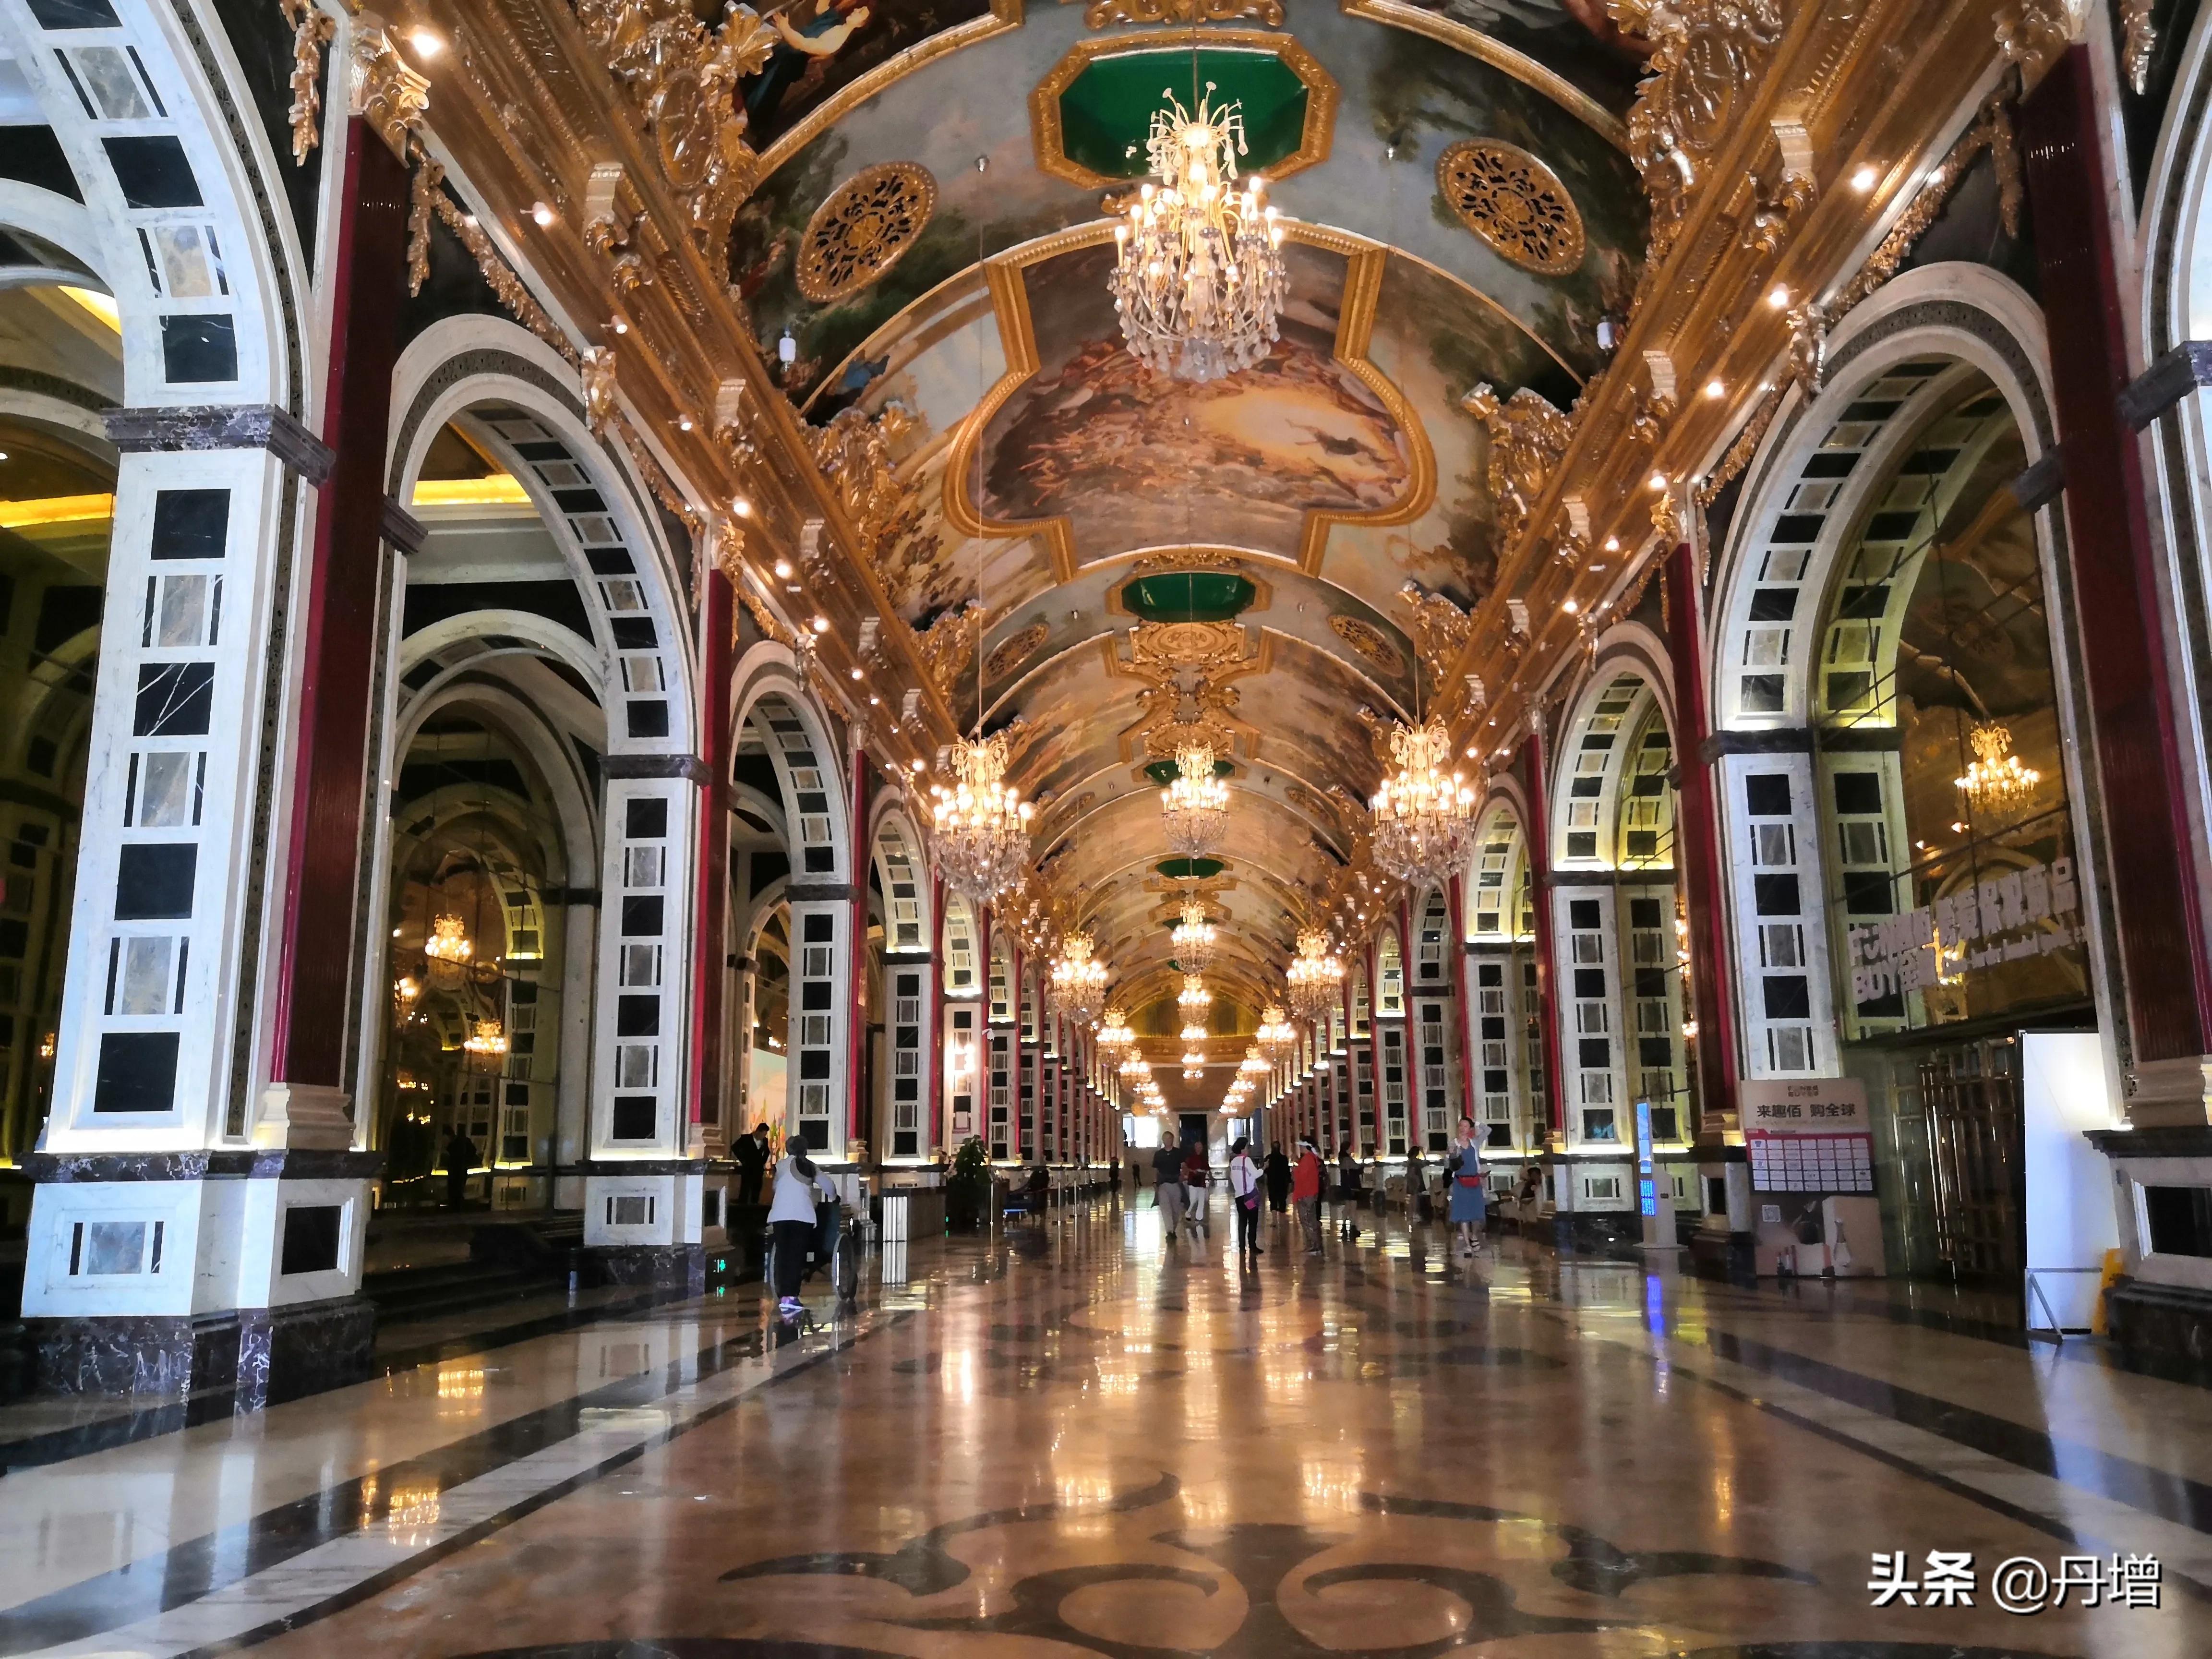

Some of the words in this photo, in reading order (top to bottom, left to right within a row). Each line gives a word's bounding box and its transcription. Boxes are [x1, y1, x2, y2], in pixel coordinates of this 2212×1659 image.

[1757, 1104, 1802, 1118] 来趣佰
[1810, 1103, 1856, 1118] 购全球
